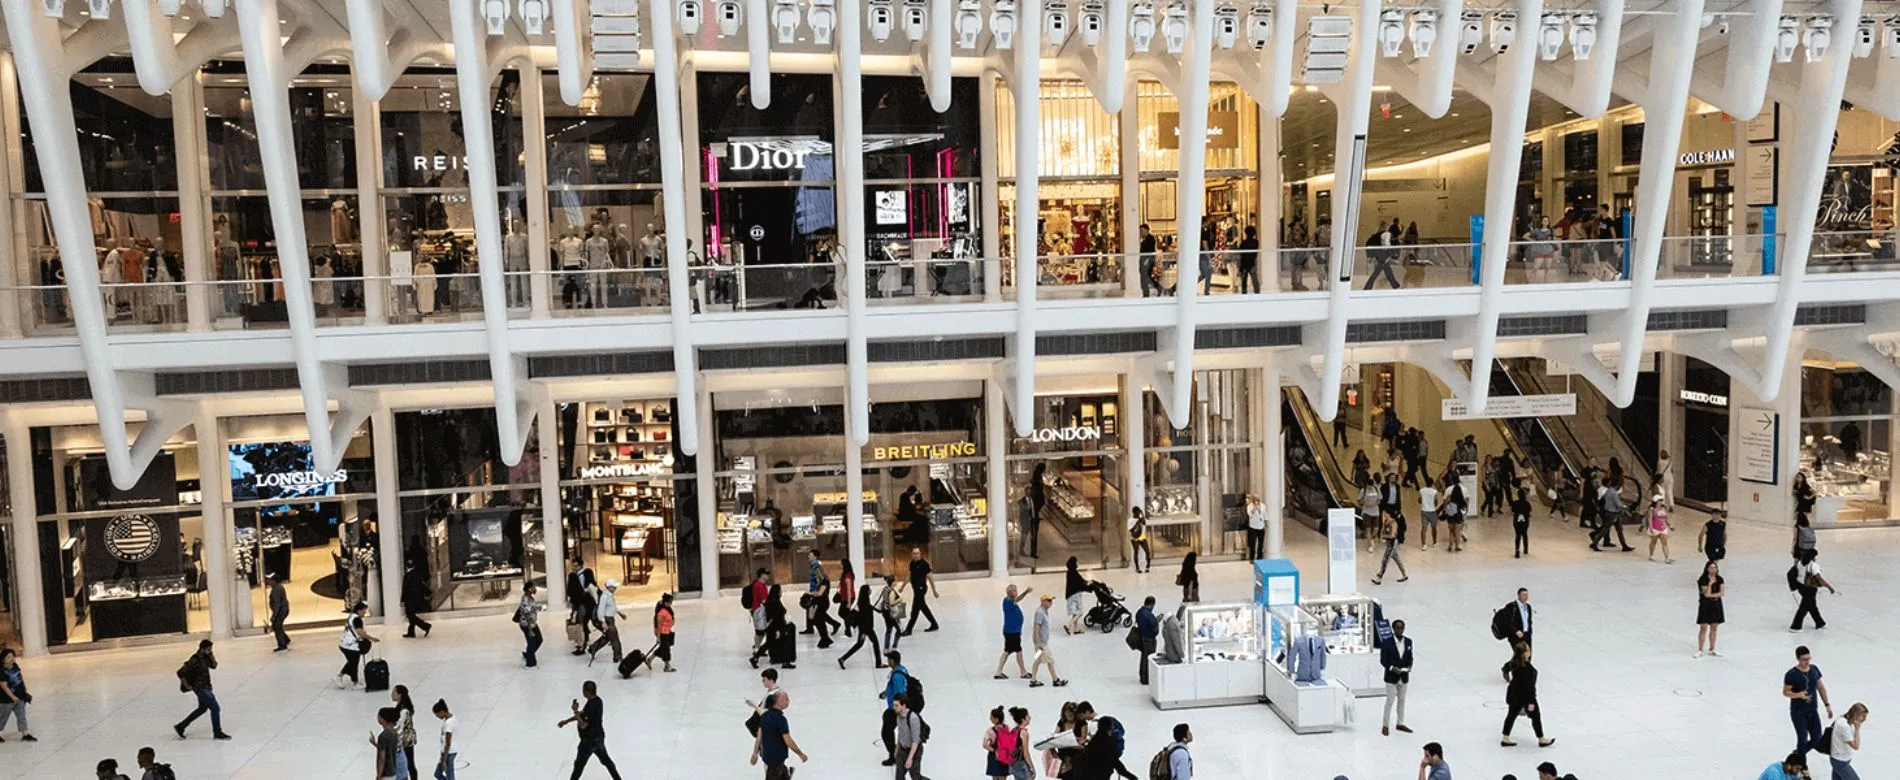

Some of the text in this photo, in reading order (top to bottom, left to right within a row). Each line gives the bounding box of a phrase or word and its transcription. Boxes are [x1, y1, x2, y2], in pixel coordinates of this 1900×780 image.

[413, 155, 468, 170] REIS
[729, 142, 811, 170] Dior
[1680, 149, 1735, 164] COLE HAAN
[1032, 426, 1101, 442] LONDON
[873, 442, 976, 460] BREITLING
[581, 464, 664, 478] MONTBLANC
